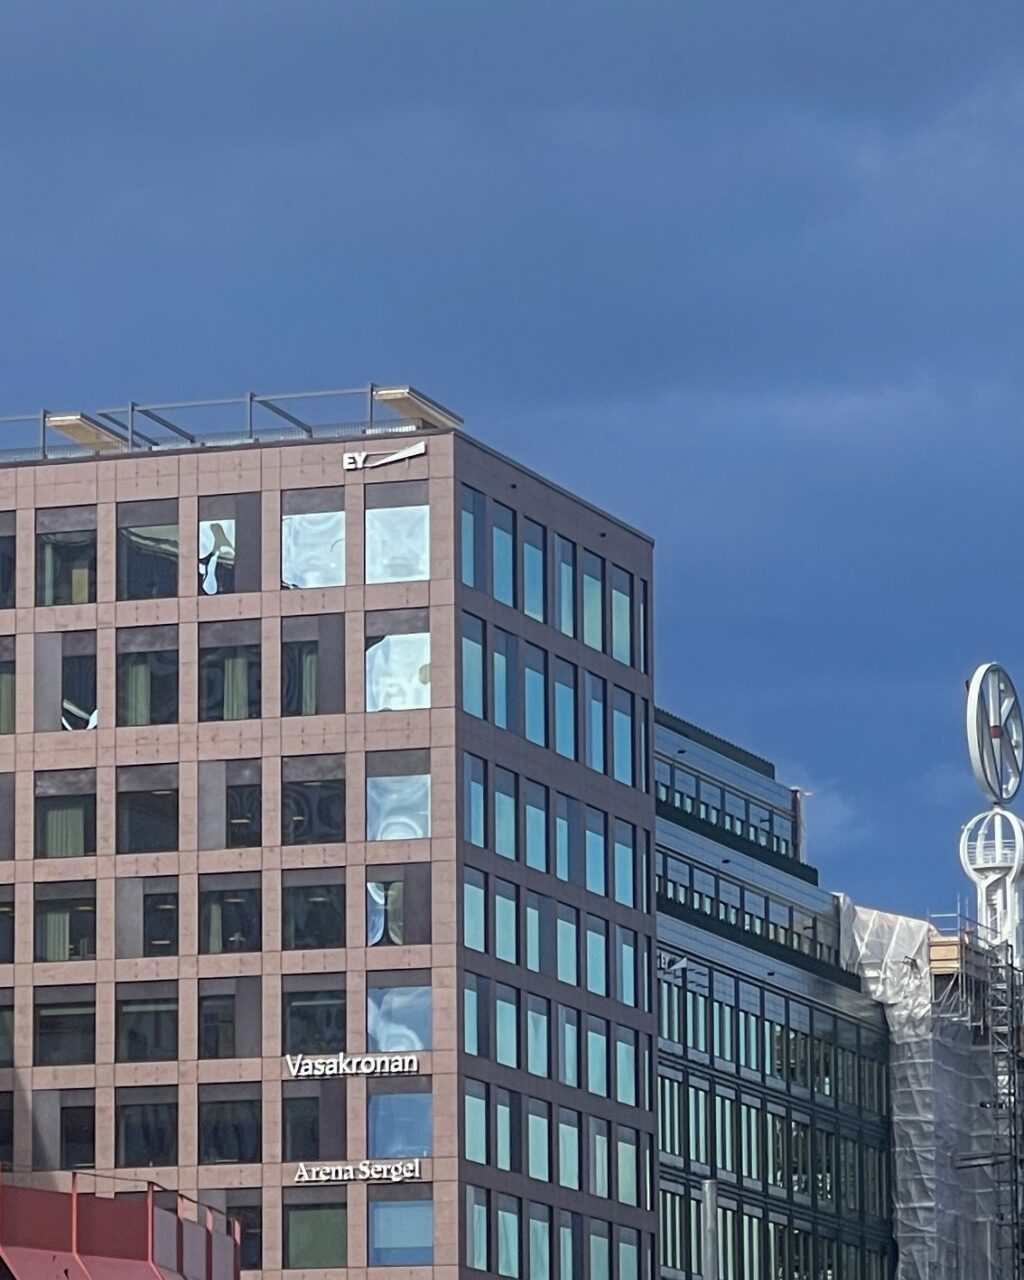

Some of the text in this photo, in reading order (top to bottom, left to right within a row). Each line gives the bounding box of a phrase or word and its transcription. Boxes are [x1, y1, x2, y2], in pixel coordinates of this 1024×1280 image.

[343, 451, 367, 470] EY
[286, 1052, 418, 1077] Vasakronan
[294, 1158, 421, 1182] Arena Sergel
